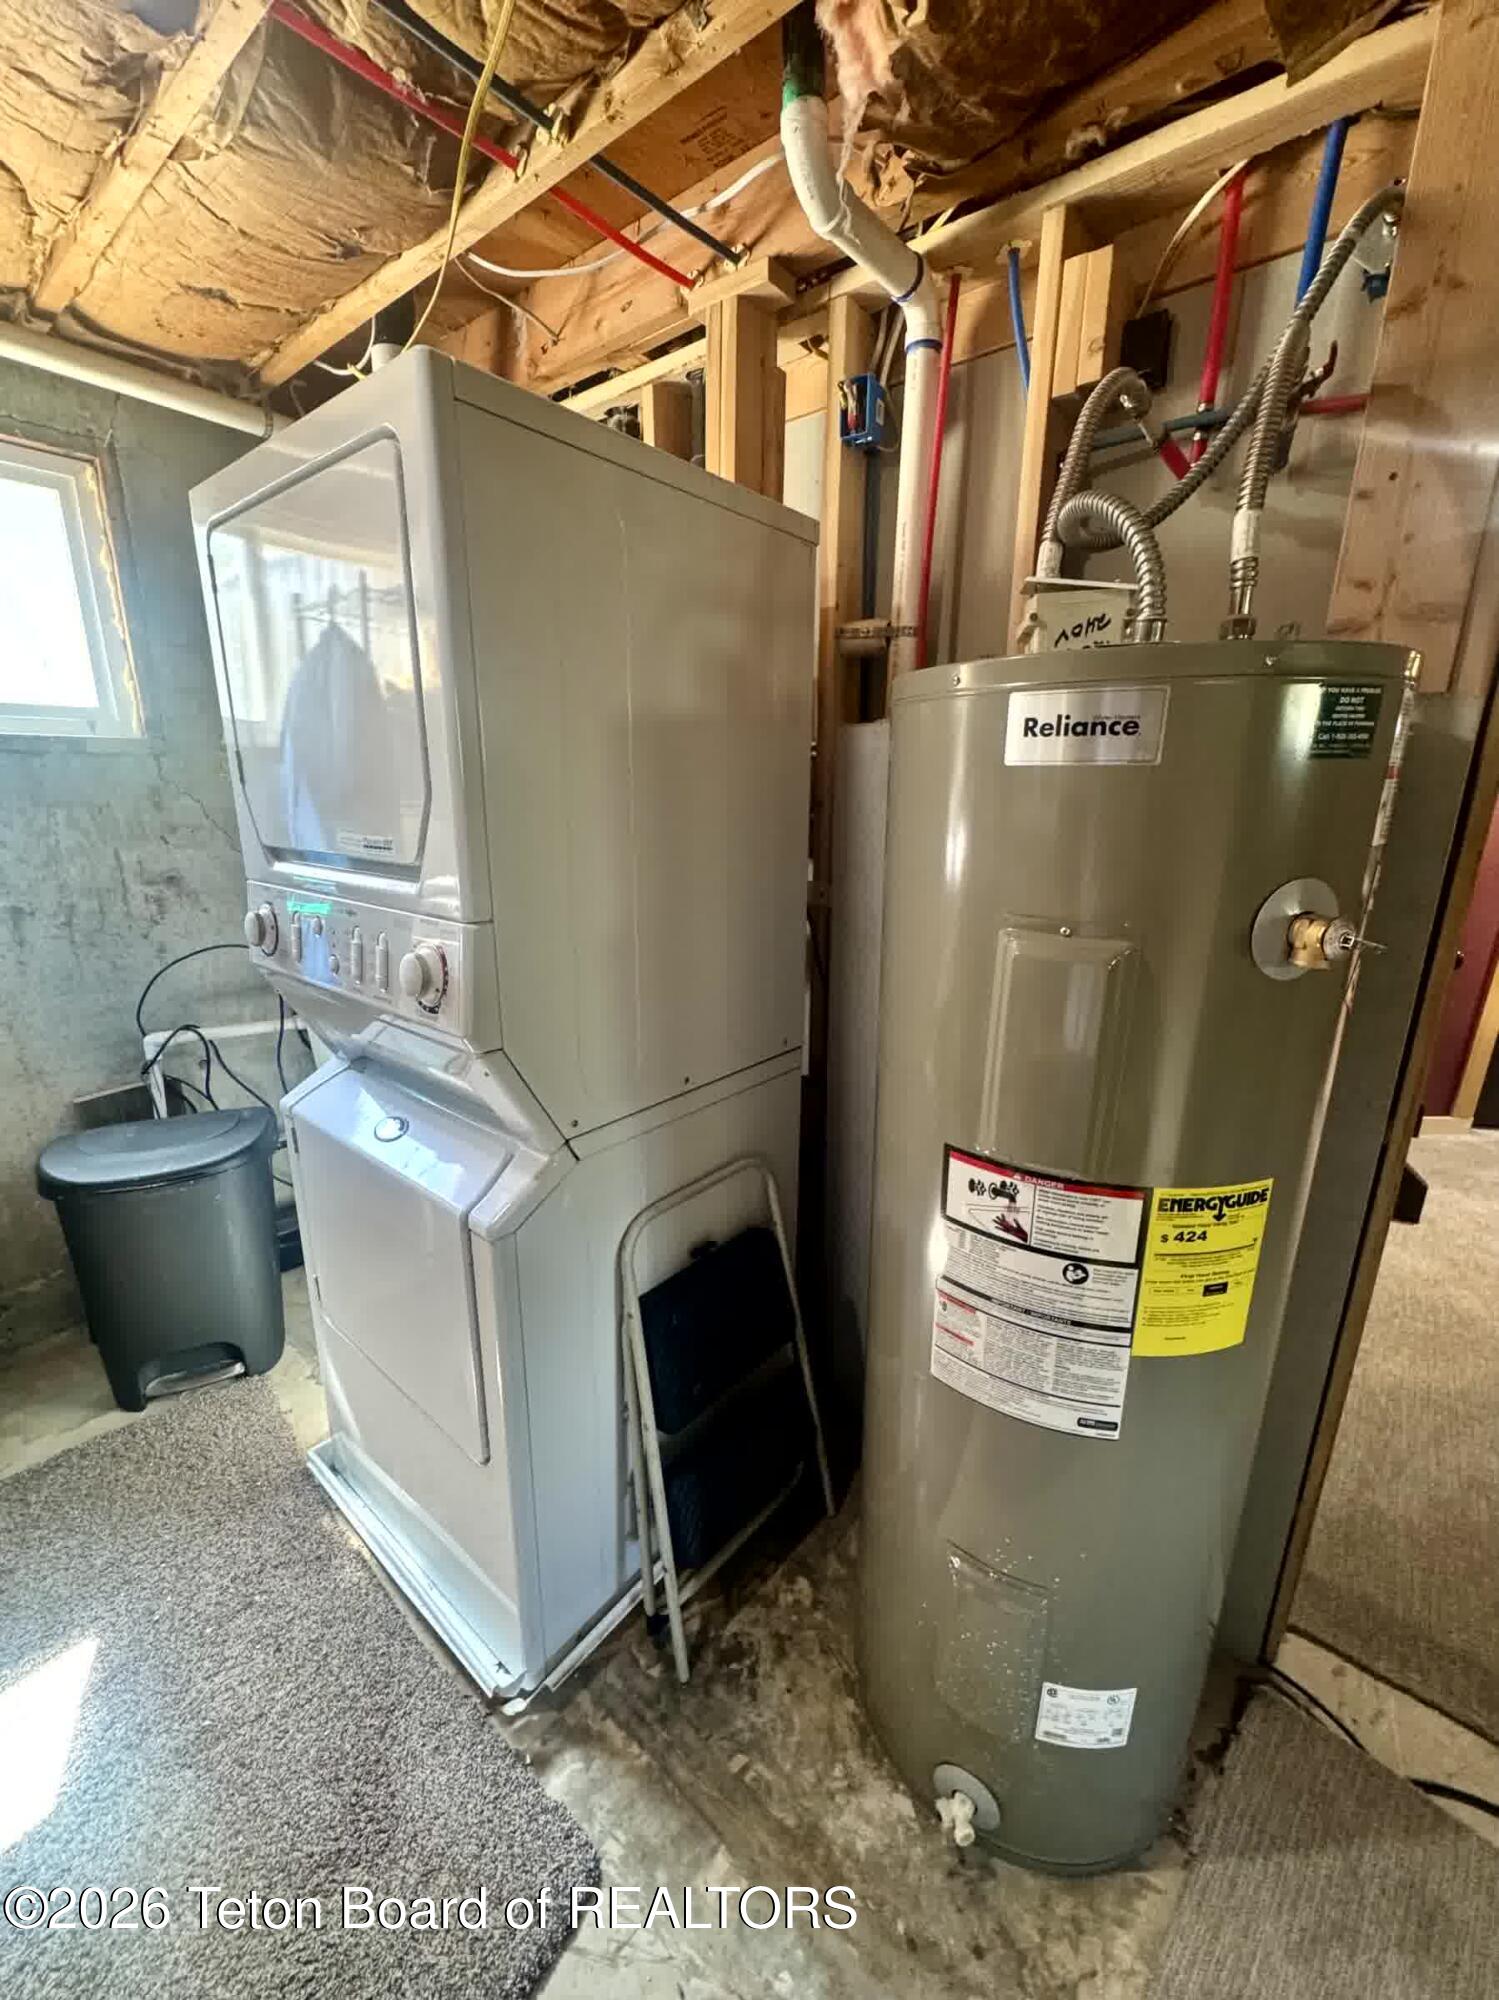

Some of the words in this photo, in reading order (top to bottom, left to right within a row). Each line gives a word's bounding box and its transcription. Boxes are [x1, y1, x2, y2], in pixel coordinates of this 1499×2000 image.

[1023, 713, 1141, 738] Reliance
[1024, 1175, 1065, 1190] DANGER
[1173, 1230, 1208, 1243] 424
